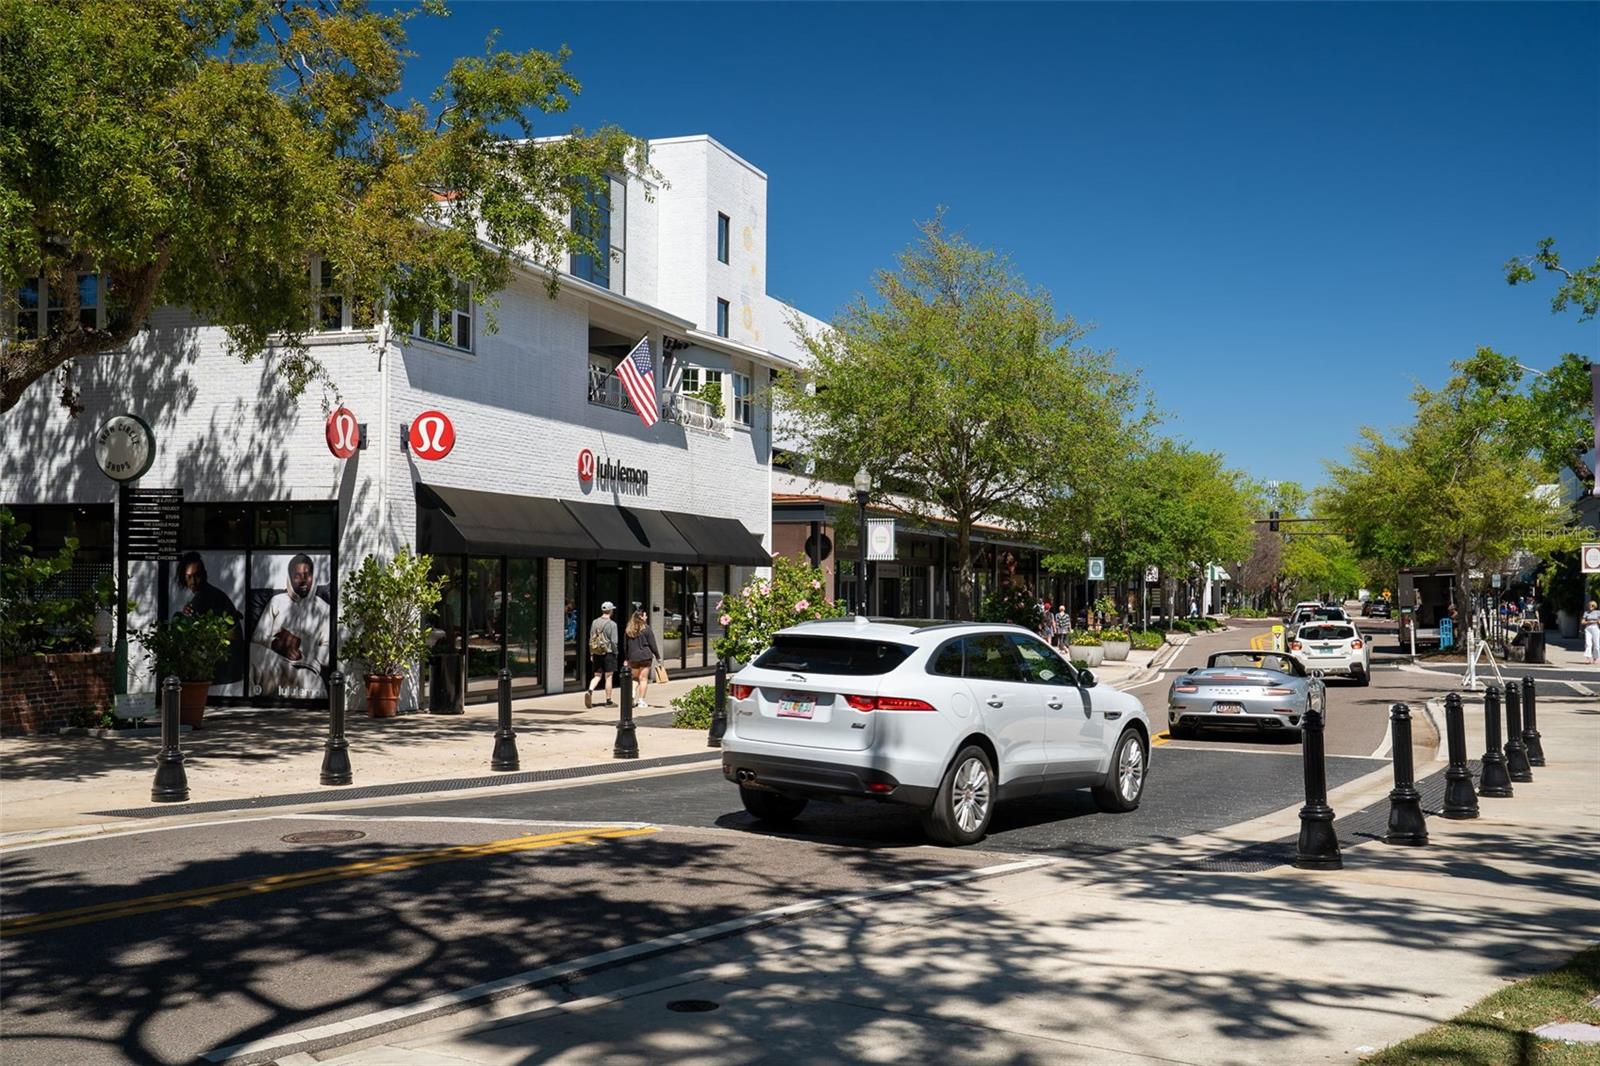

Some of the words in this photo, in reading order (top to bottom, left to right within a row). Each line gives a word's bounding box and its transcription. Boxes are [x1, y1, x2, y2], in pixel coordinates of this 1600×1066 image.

[118, 423, 140, 445] CIRCLE
[106, 461, 131, 472] SHOPS
[596, 456, 649, 486] lululemon
